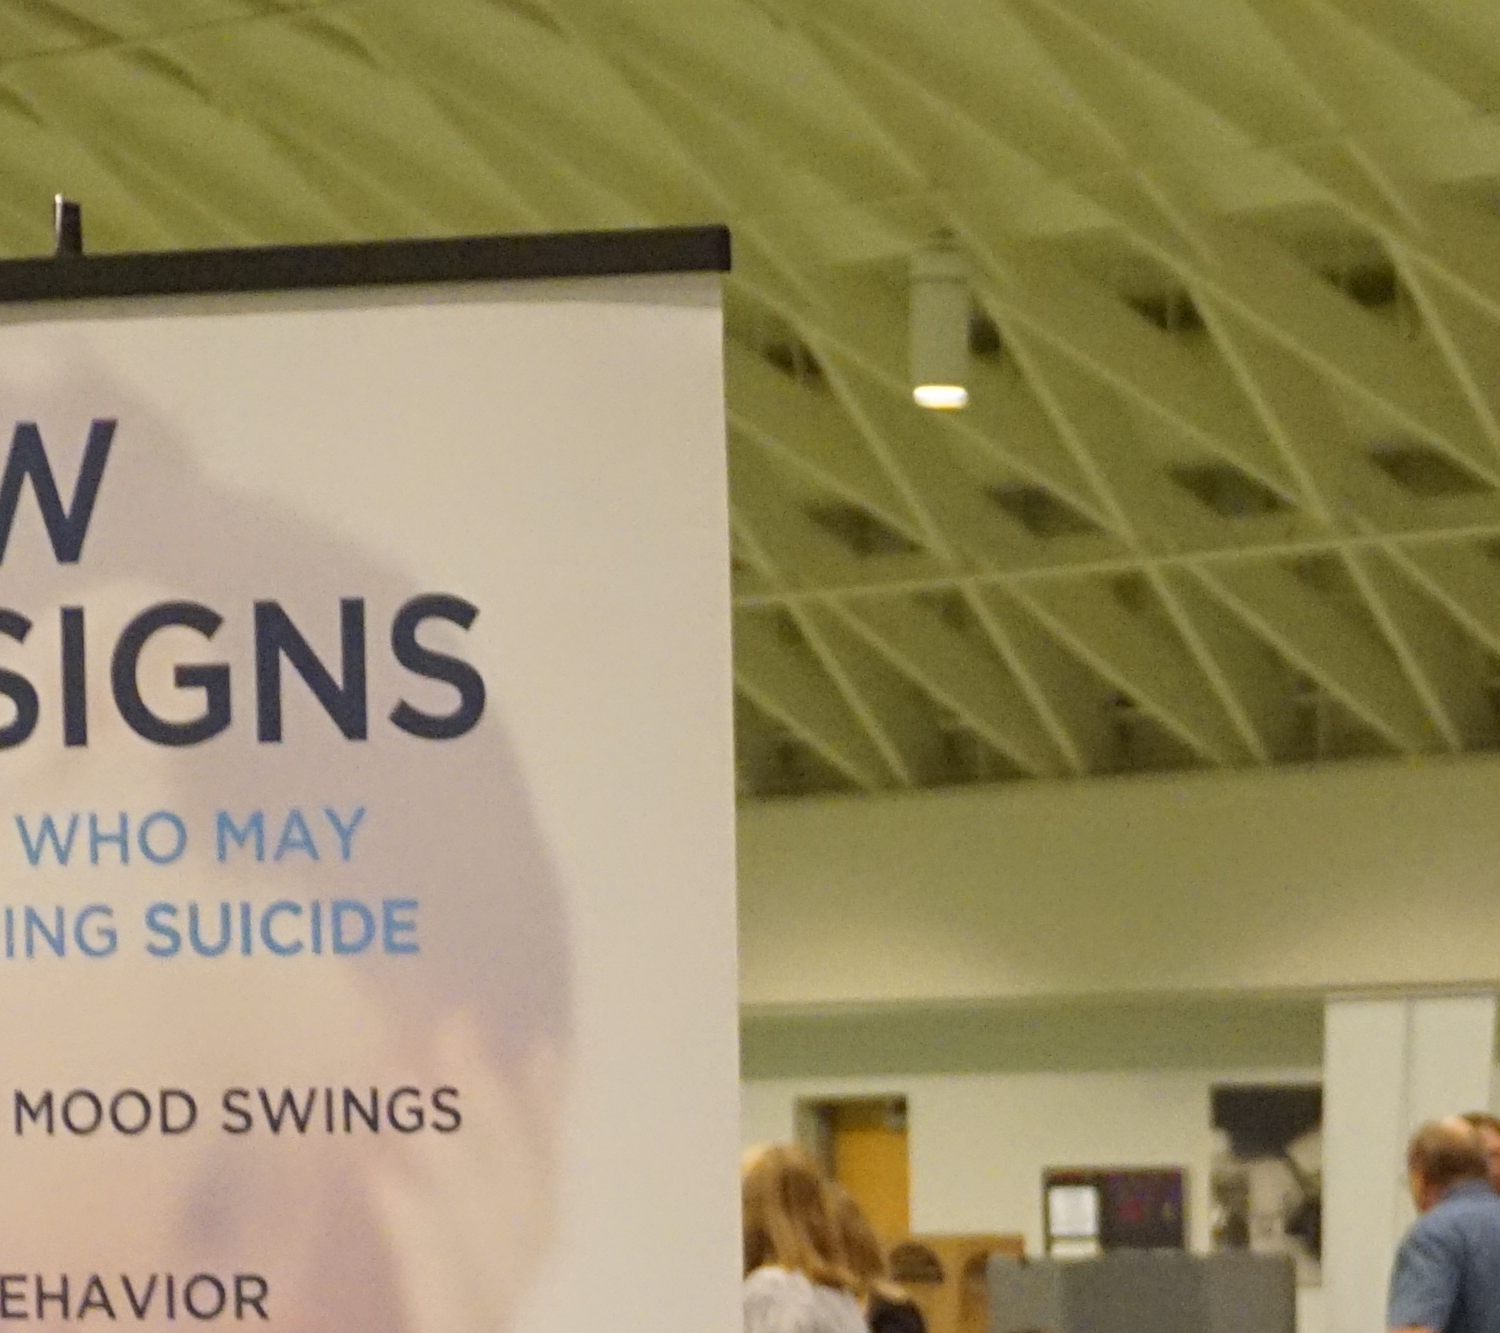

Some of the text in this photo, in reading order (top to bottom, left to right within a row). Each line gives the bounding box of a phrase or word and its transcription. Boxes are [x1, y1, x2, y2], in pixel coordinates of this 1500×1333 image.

[14, 809, 189, 868] WHO
[214, 805, 367, 864] MAY
[144, 898, 421, 959] SUICIDE
[13, 1088, 199, 1137] MOOD
[221, 1085, 463, 1136] SWINGS
